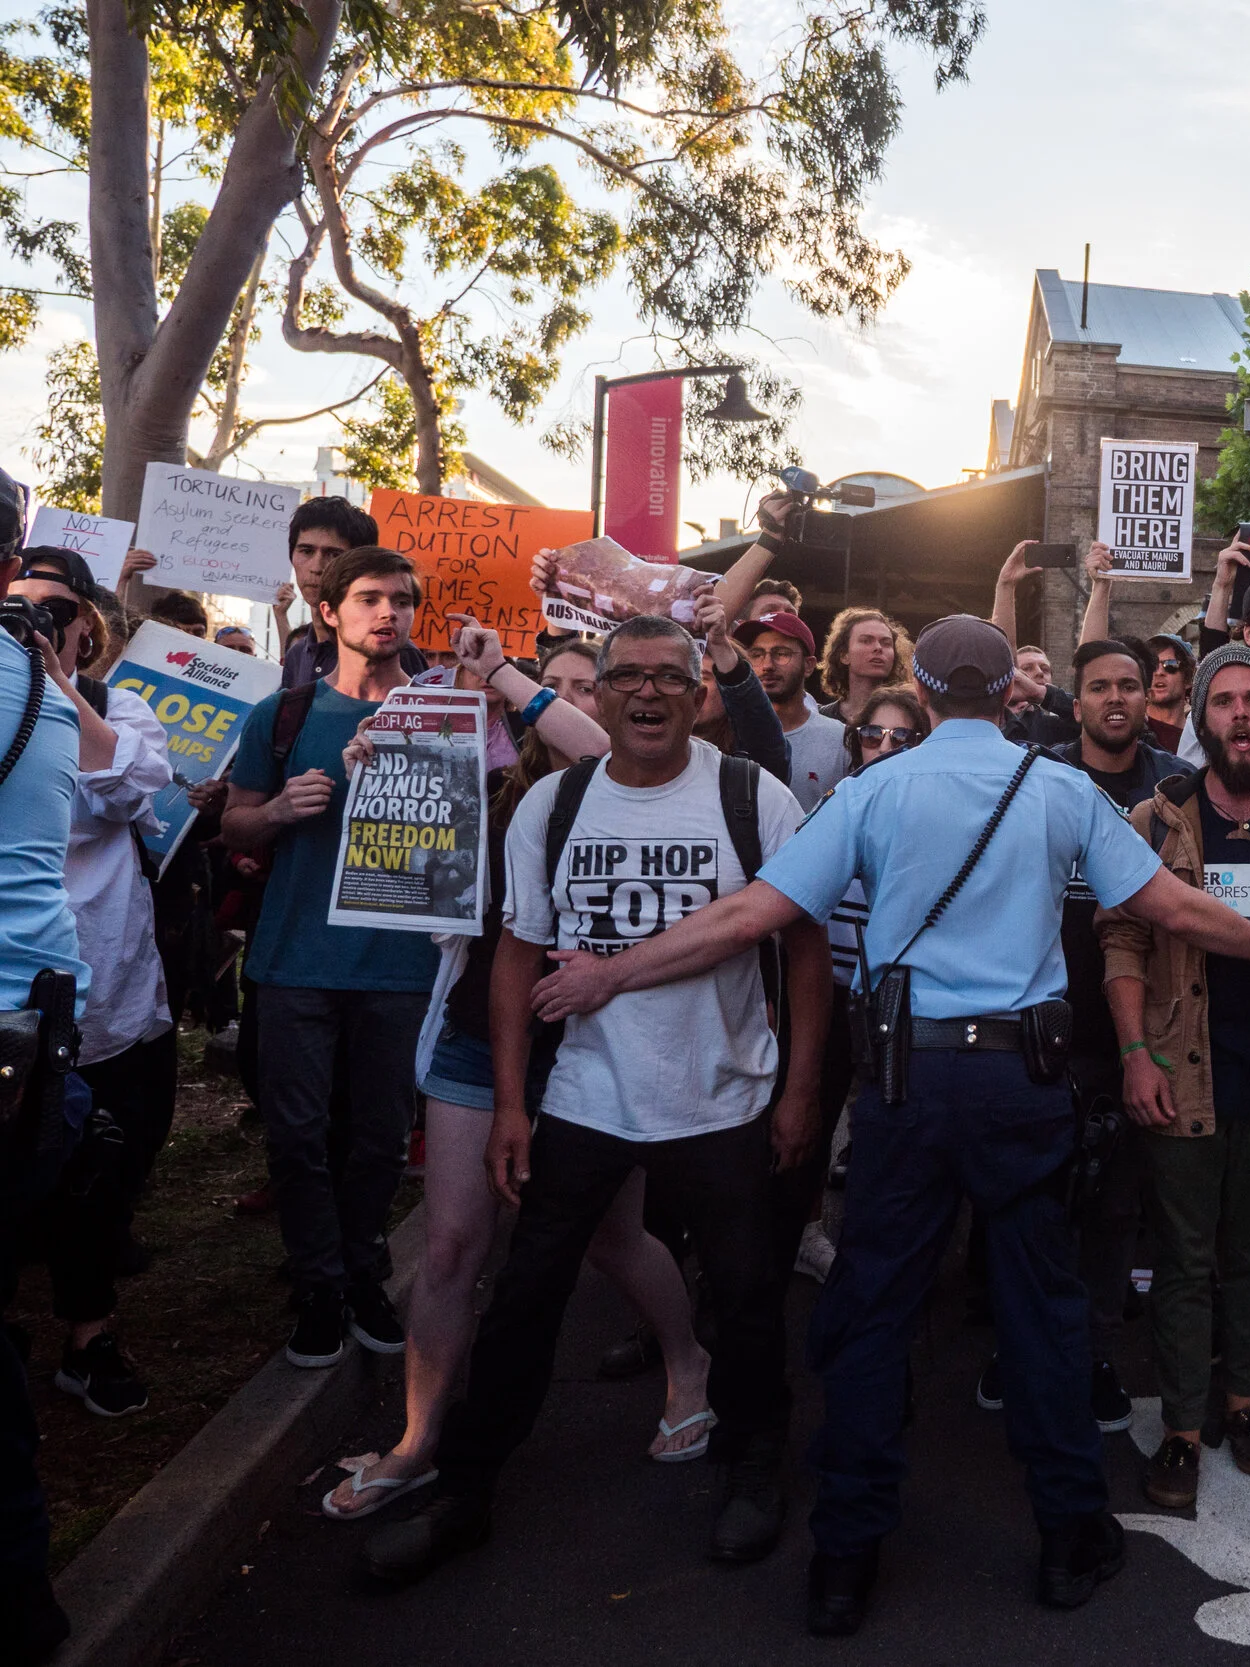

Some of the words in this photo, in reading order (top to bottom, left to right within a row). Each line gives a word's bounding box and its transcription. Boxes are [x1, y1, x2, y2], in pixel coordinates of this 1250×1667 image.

[649, 417, 672, 516] innovation
[1112, 451, 1188, 482] BRING
[167, 474, 285, 512] TORTURING
[1114, 484, 1182, 515] THEM
[66, 514, 109, 534] NOT
[154, 499, 213, 523] Asylum
[386, 497, 530, 533] ARREST
[57, 532, 90, 551] IN
[170, 530, 250, 554] Refugees
[202, 525, 232, 537] and
[1116, 518, 1180, 548] HERE
[397, 531, 519, 559] DUTTON
[1114, 550, 1150, 561] EVACUATE
[1151, 551, 1179, 562] MANUS
[183, 555, 240, 570] BLOODY
[436, 557, 480, 576] FOR
[1124, 560, 1140, 570] AND
[1142, 561, 1167, 571] NAURU
[423, 576, 499, 606] IMES
[182, 666, 231, 690] Alliance
[187, 657, 239, 681] Socialist
[372, 713, 423, 729] EDFLAG
[167, 734, 216, 763] MPS
[358, 774, 445, 800] MANUS
[352, 797, 453, 824] HORROR
[350, 821, 456, 851] FREEDOM
[346, 845, 412, 872] NOW!
[571, 844, 628, 876] HIP
[641, 844, 713, 876] HOP
[568, 881, 711, 937] FOR
